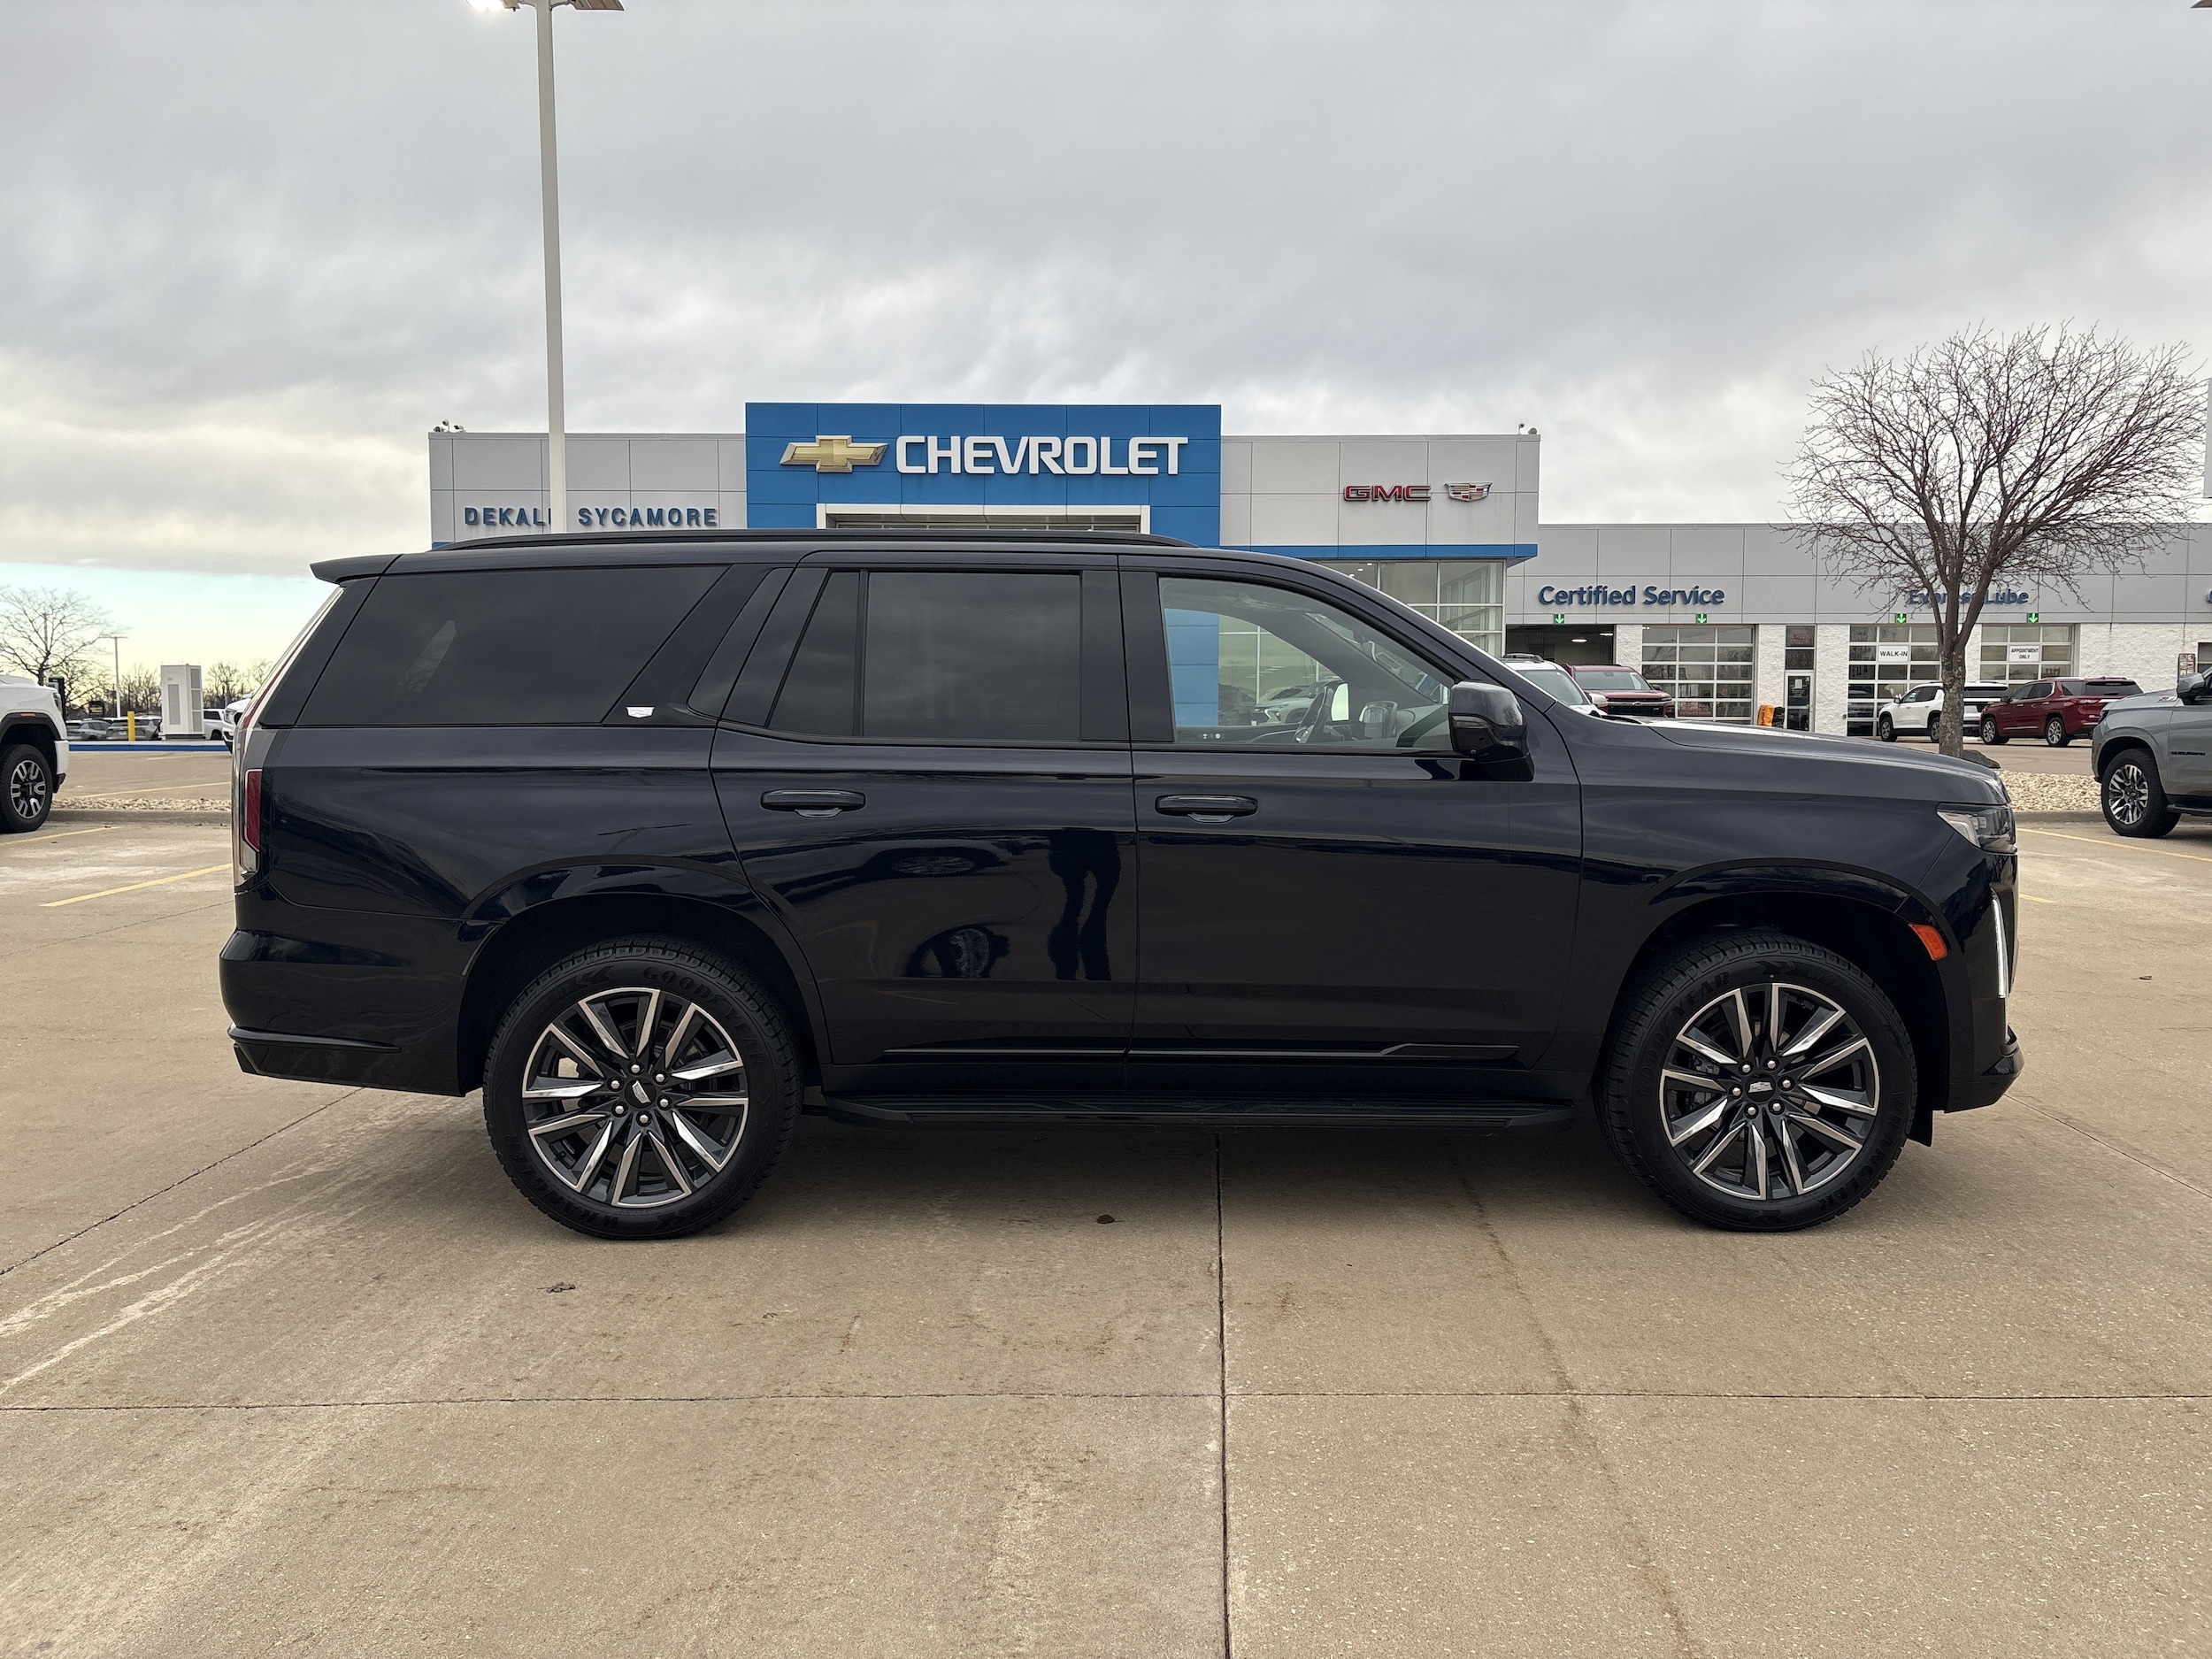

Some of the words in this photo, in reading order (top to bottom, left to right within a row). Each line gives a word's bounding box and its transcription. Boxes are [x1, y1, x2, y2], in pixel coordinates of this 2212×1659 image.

[895, 435, 1189, 475] CHEVROLET
[1343, 485, 1431, 503] GMC
[464, 507, 551, 526] DEKAL
[578, 507, 718, 526] SYCAMORE
[1538, 585, 1637, 605] Certified
[1643, 585, 1726, 605] Service
[1985, 588, 2030, 605] Lube
